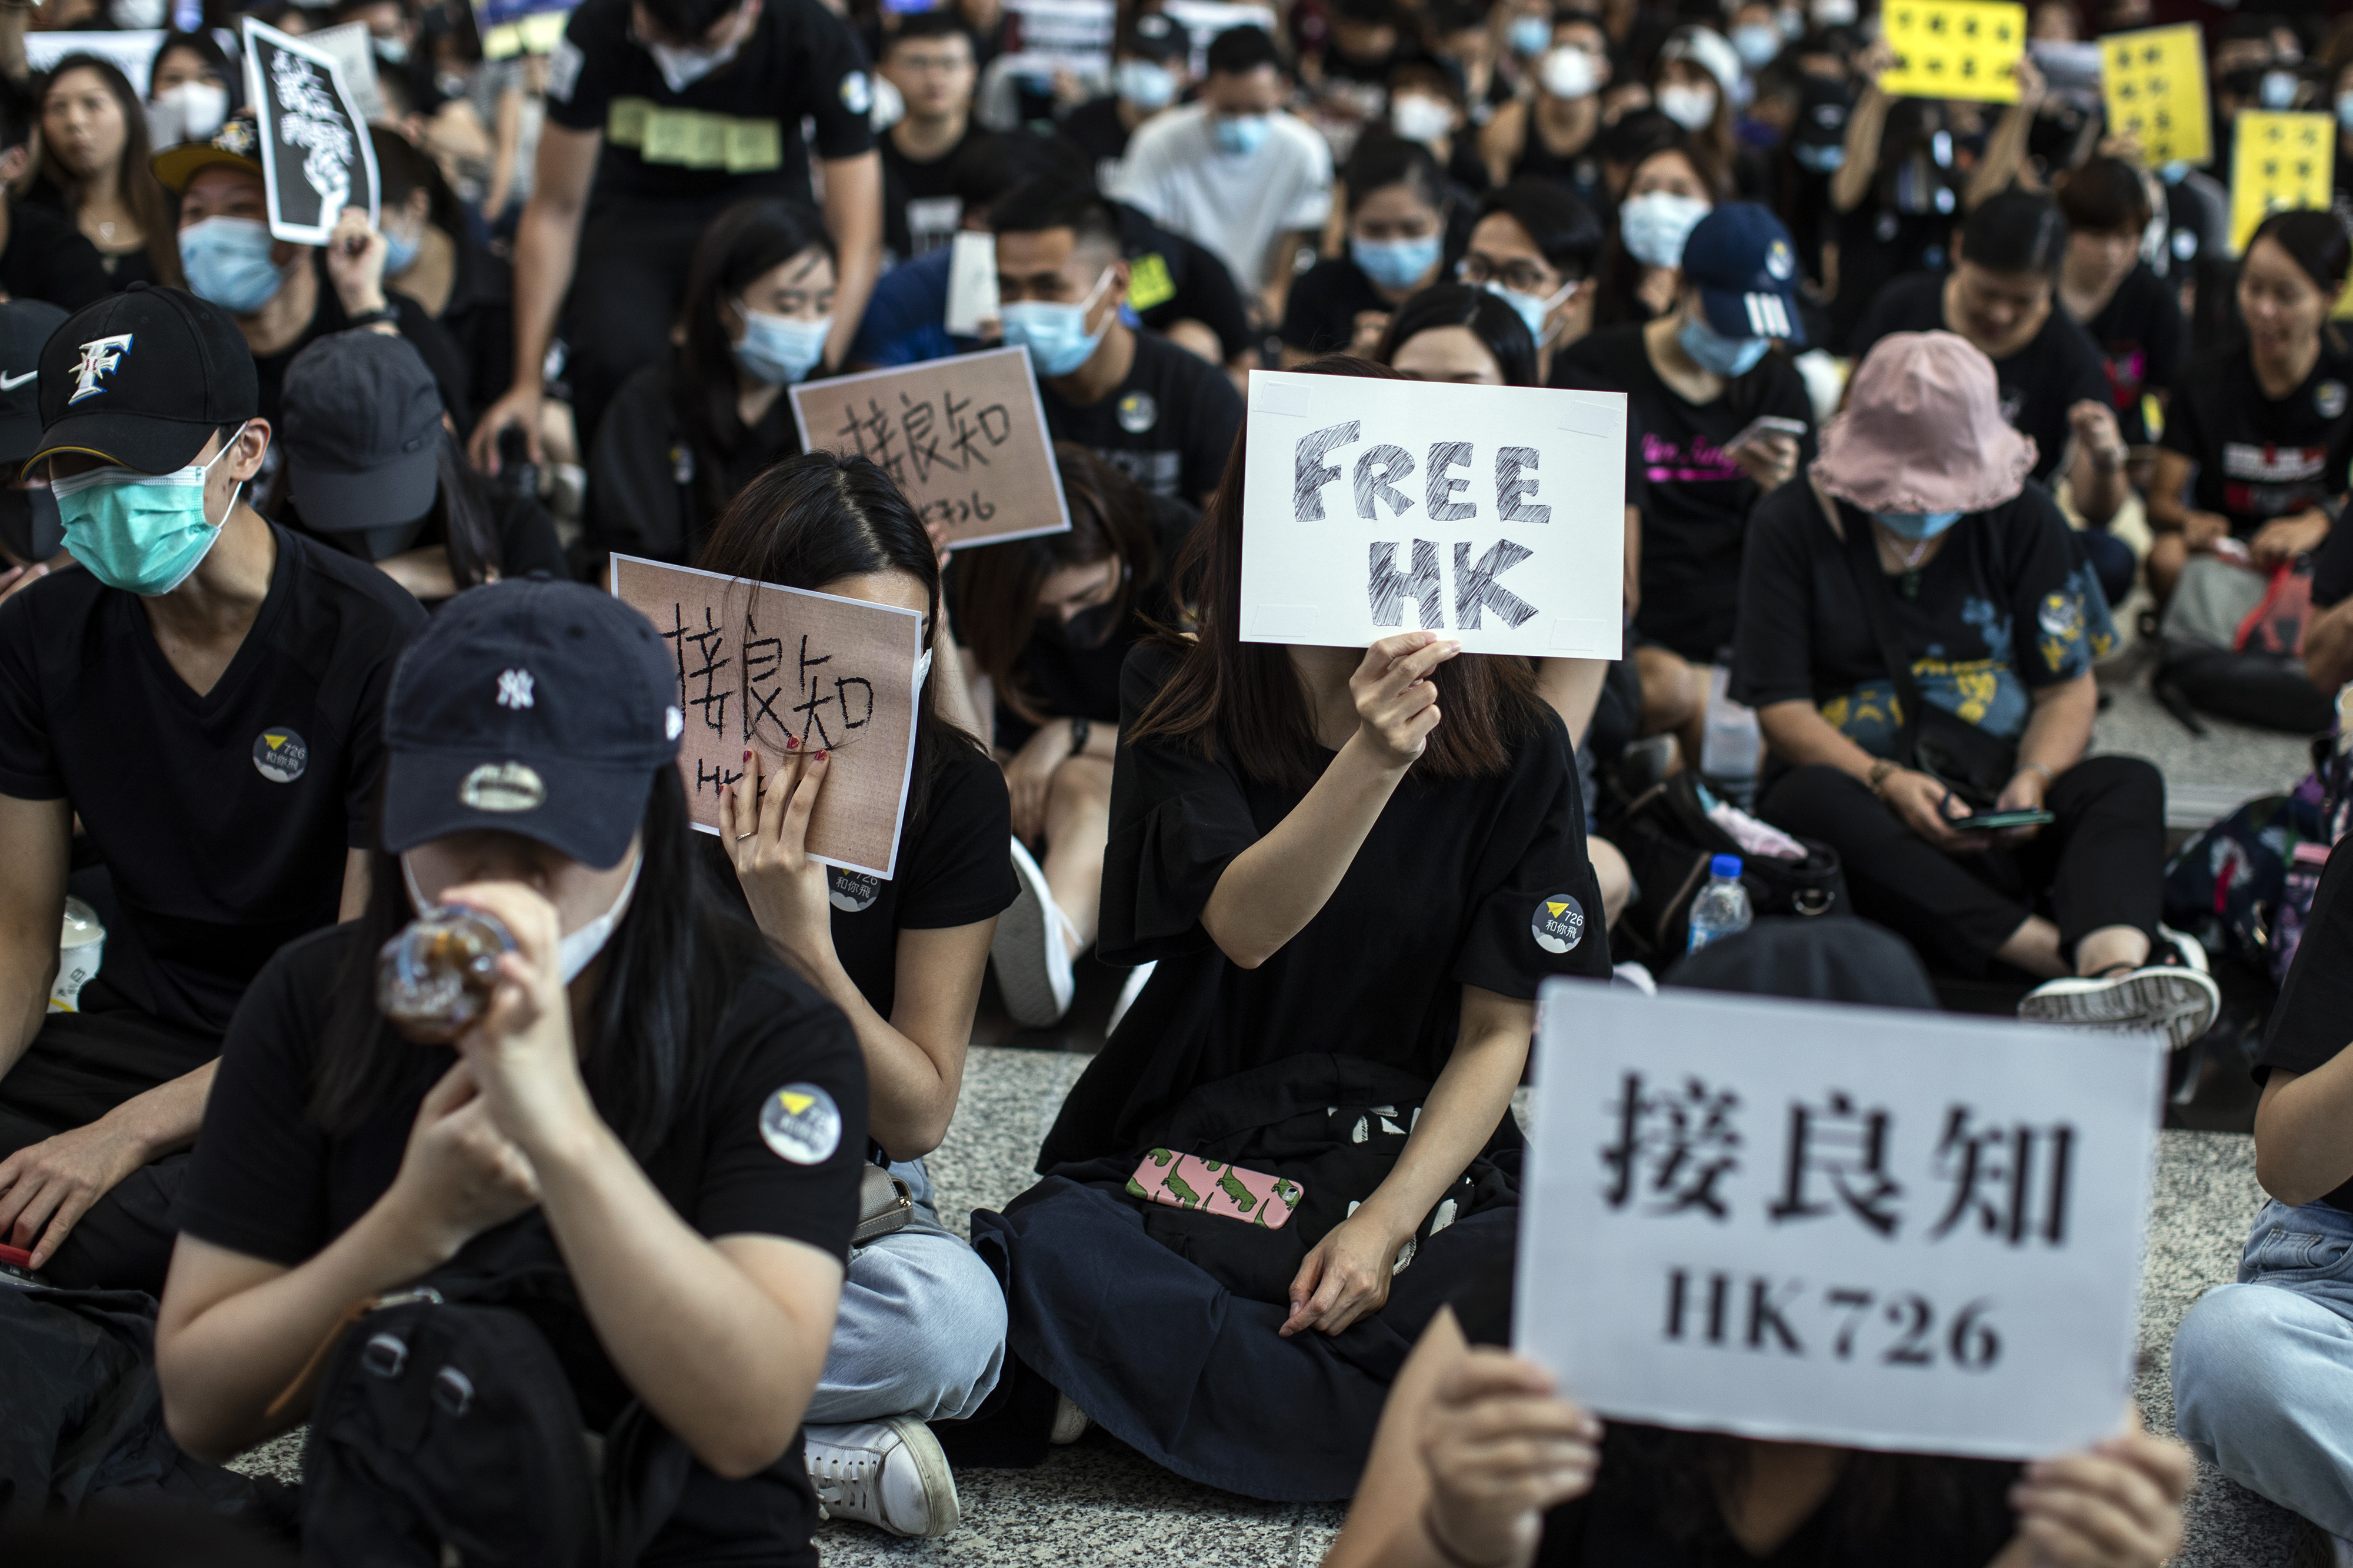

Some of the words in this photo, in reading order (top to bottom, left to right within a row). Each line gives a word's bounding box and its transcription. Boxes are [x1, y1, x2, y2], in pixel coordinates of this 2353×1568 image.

[838, 391, 1011, 483] 接良知
[1292, 420, 1552, 523] FREE
[1367, 538, 1539, 630] HK
[659, 603, 874, 750] 接良知
[284, 742, 306, 760] 726
[836, 876, 871, 898] 和你飛
[1545, 919, 1577, 939] 和你飛
[1565, 910, 1584, 926] 726
[1599, 1066, 2078, 1249] 接良知
[1662, 1263, 2004, 1374] HK726
